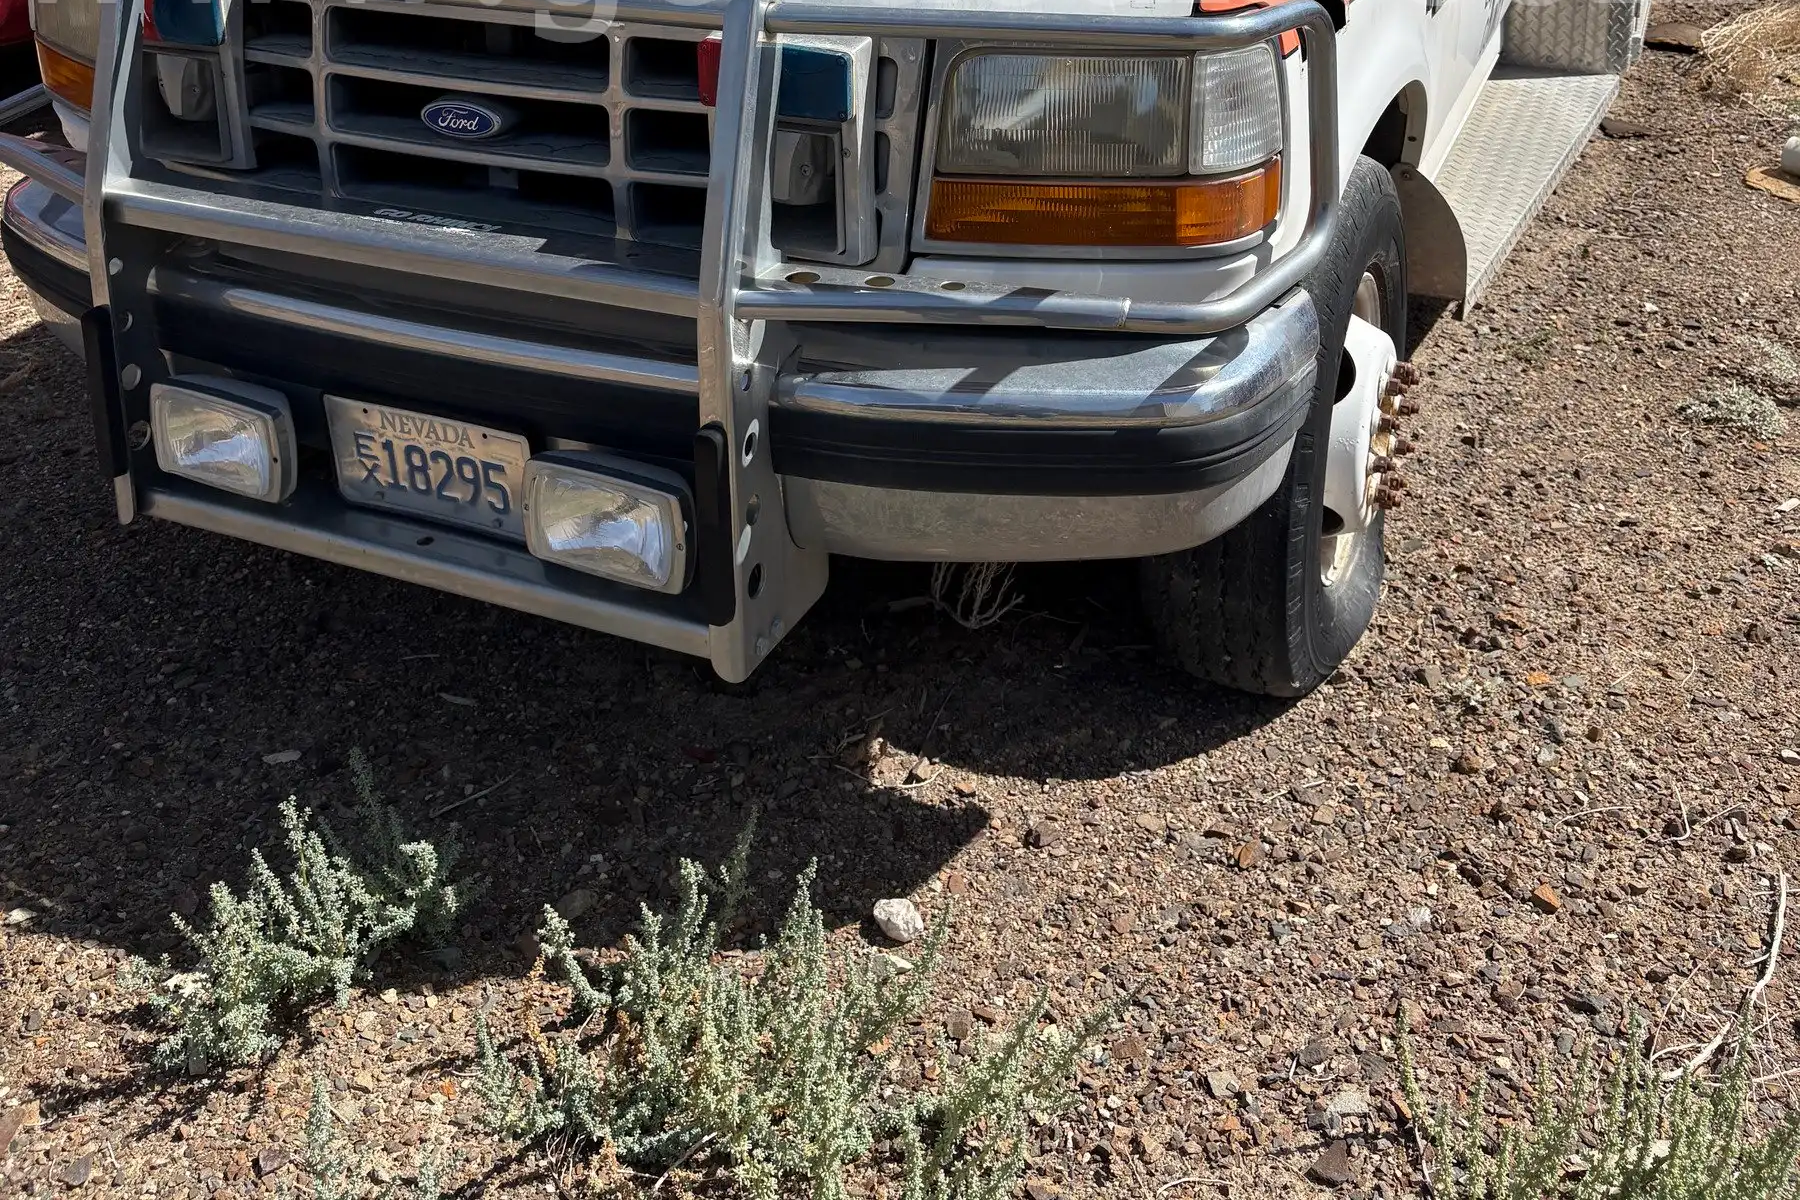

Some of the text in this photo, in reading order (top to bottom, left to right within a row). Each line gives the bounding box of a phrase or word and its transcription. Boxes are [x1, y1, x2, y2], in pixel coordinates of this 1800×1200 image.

[438, 108, 479, 130] Ford
[378, 409, 475, 449] NEVADA
[381, 437, 512, 516] 18295
